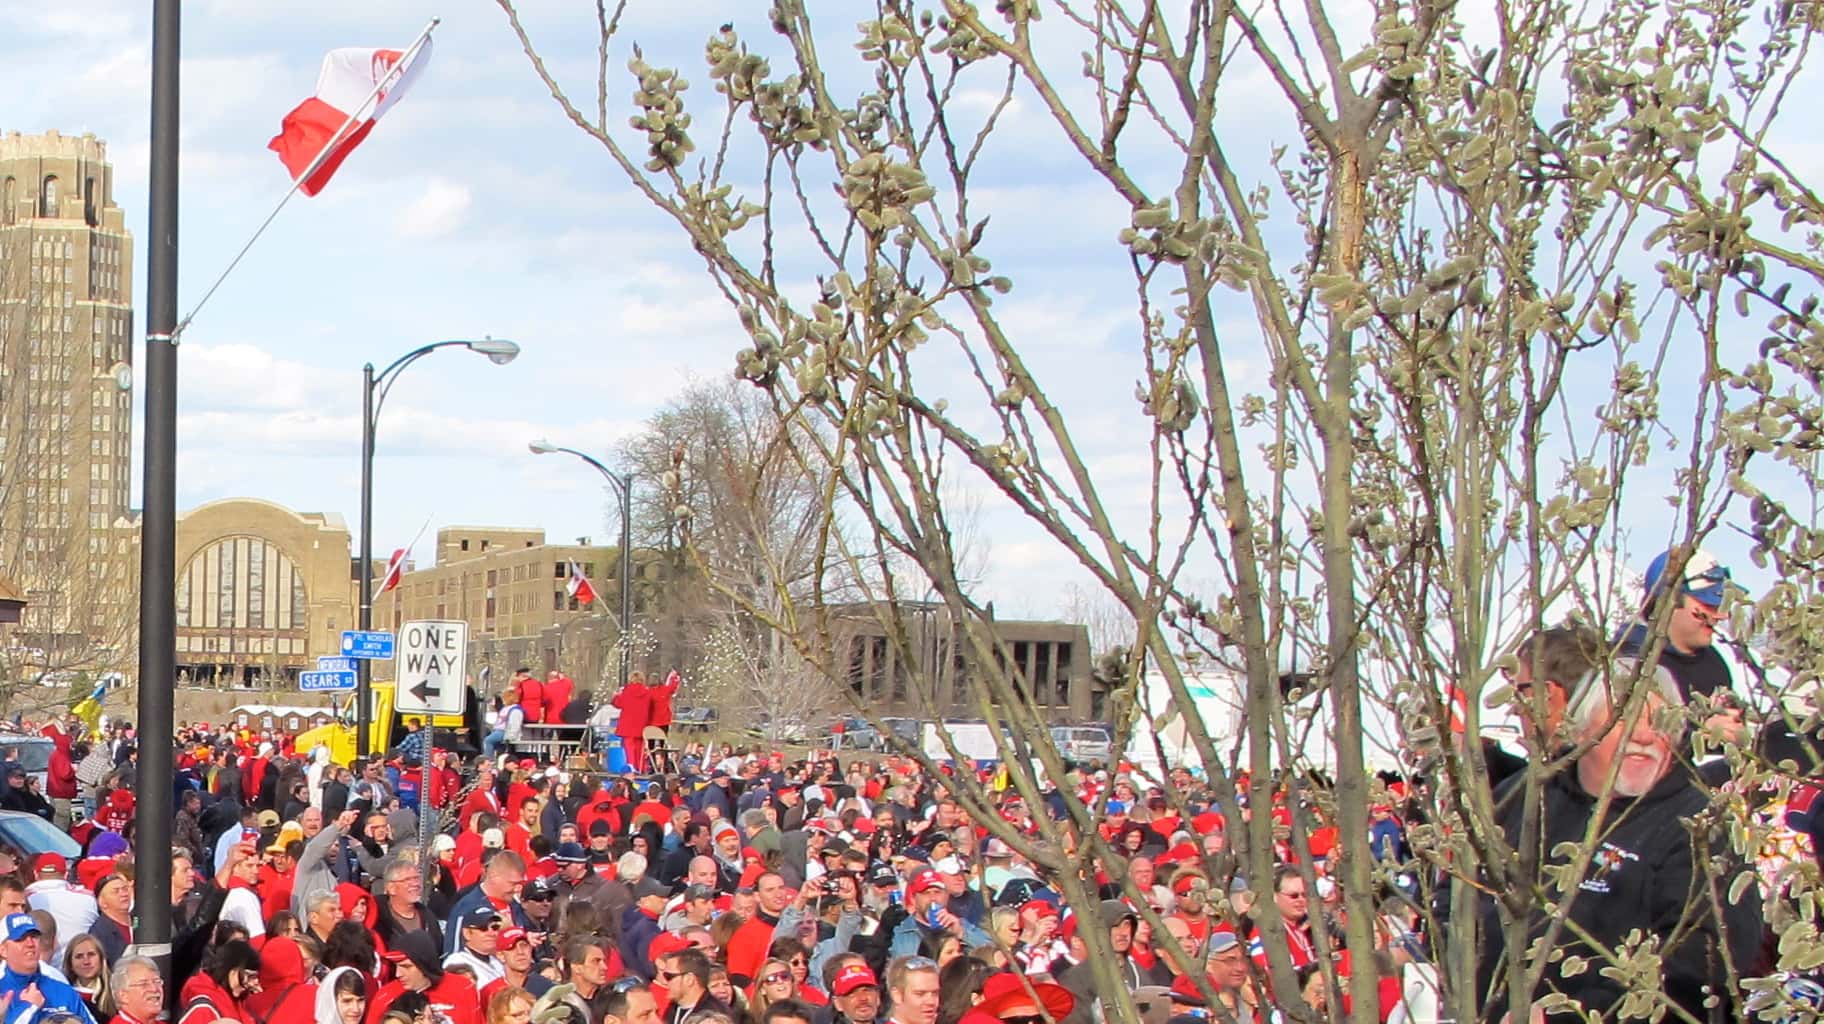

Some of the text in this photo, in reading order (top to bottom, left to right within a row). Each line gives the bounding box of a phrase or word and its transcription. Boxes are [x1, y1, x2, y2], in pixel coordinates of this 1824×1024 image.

[408, 628, 457, 650] ONE
[407, 653, 457, 675] WAY
[303, 674, 341, 688] SEARS
